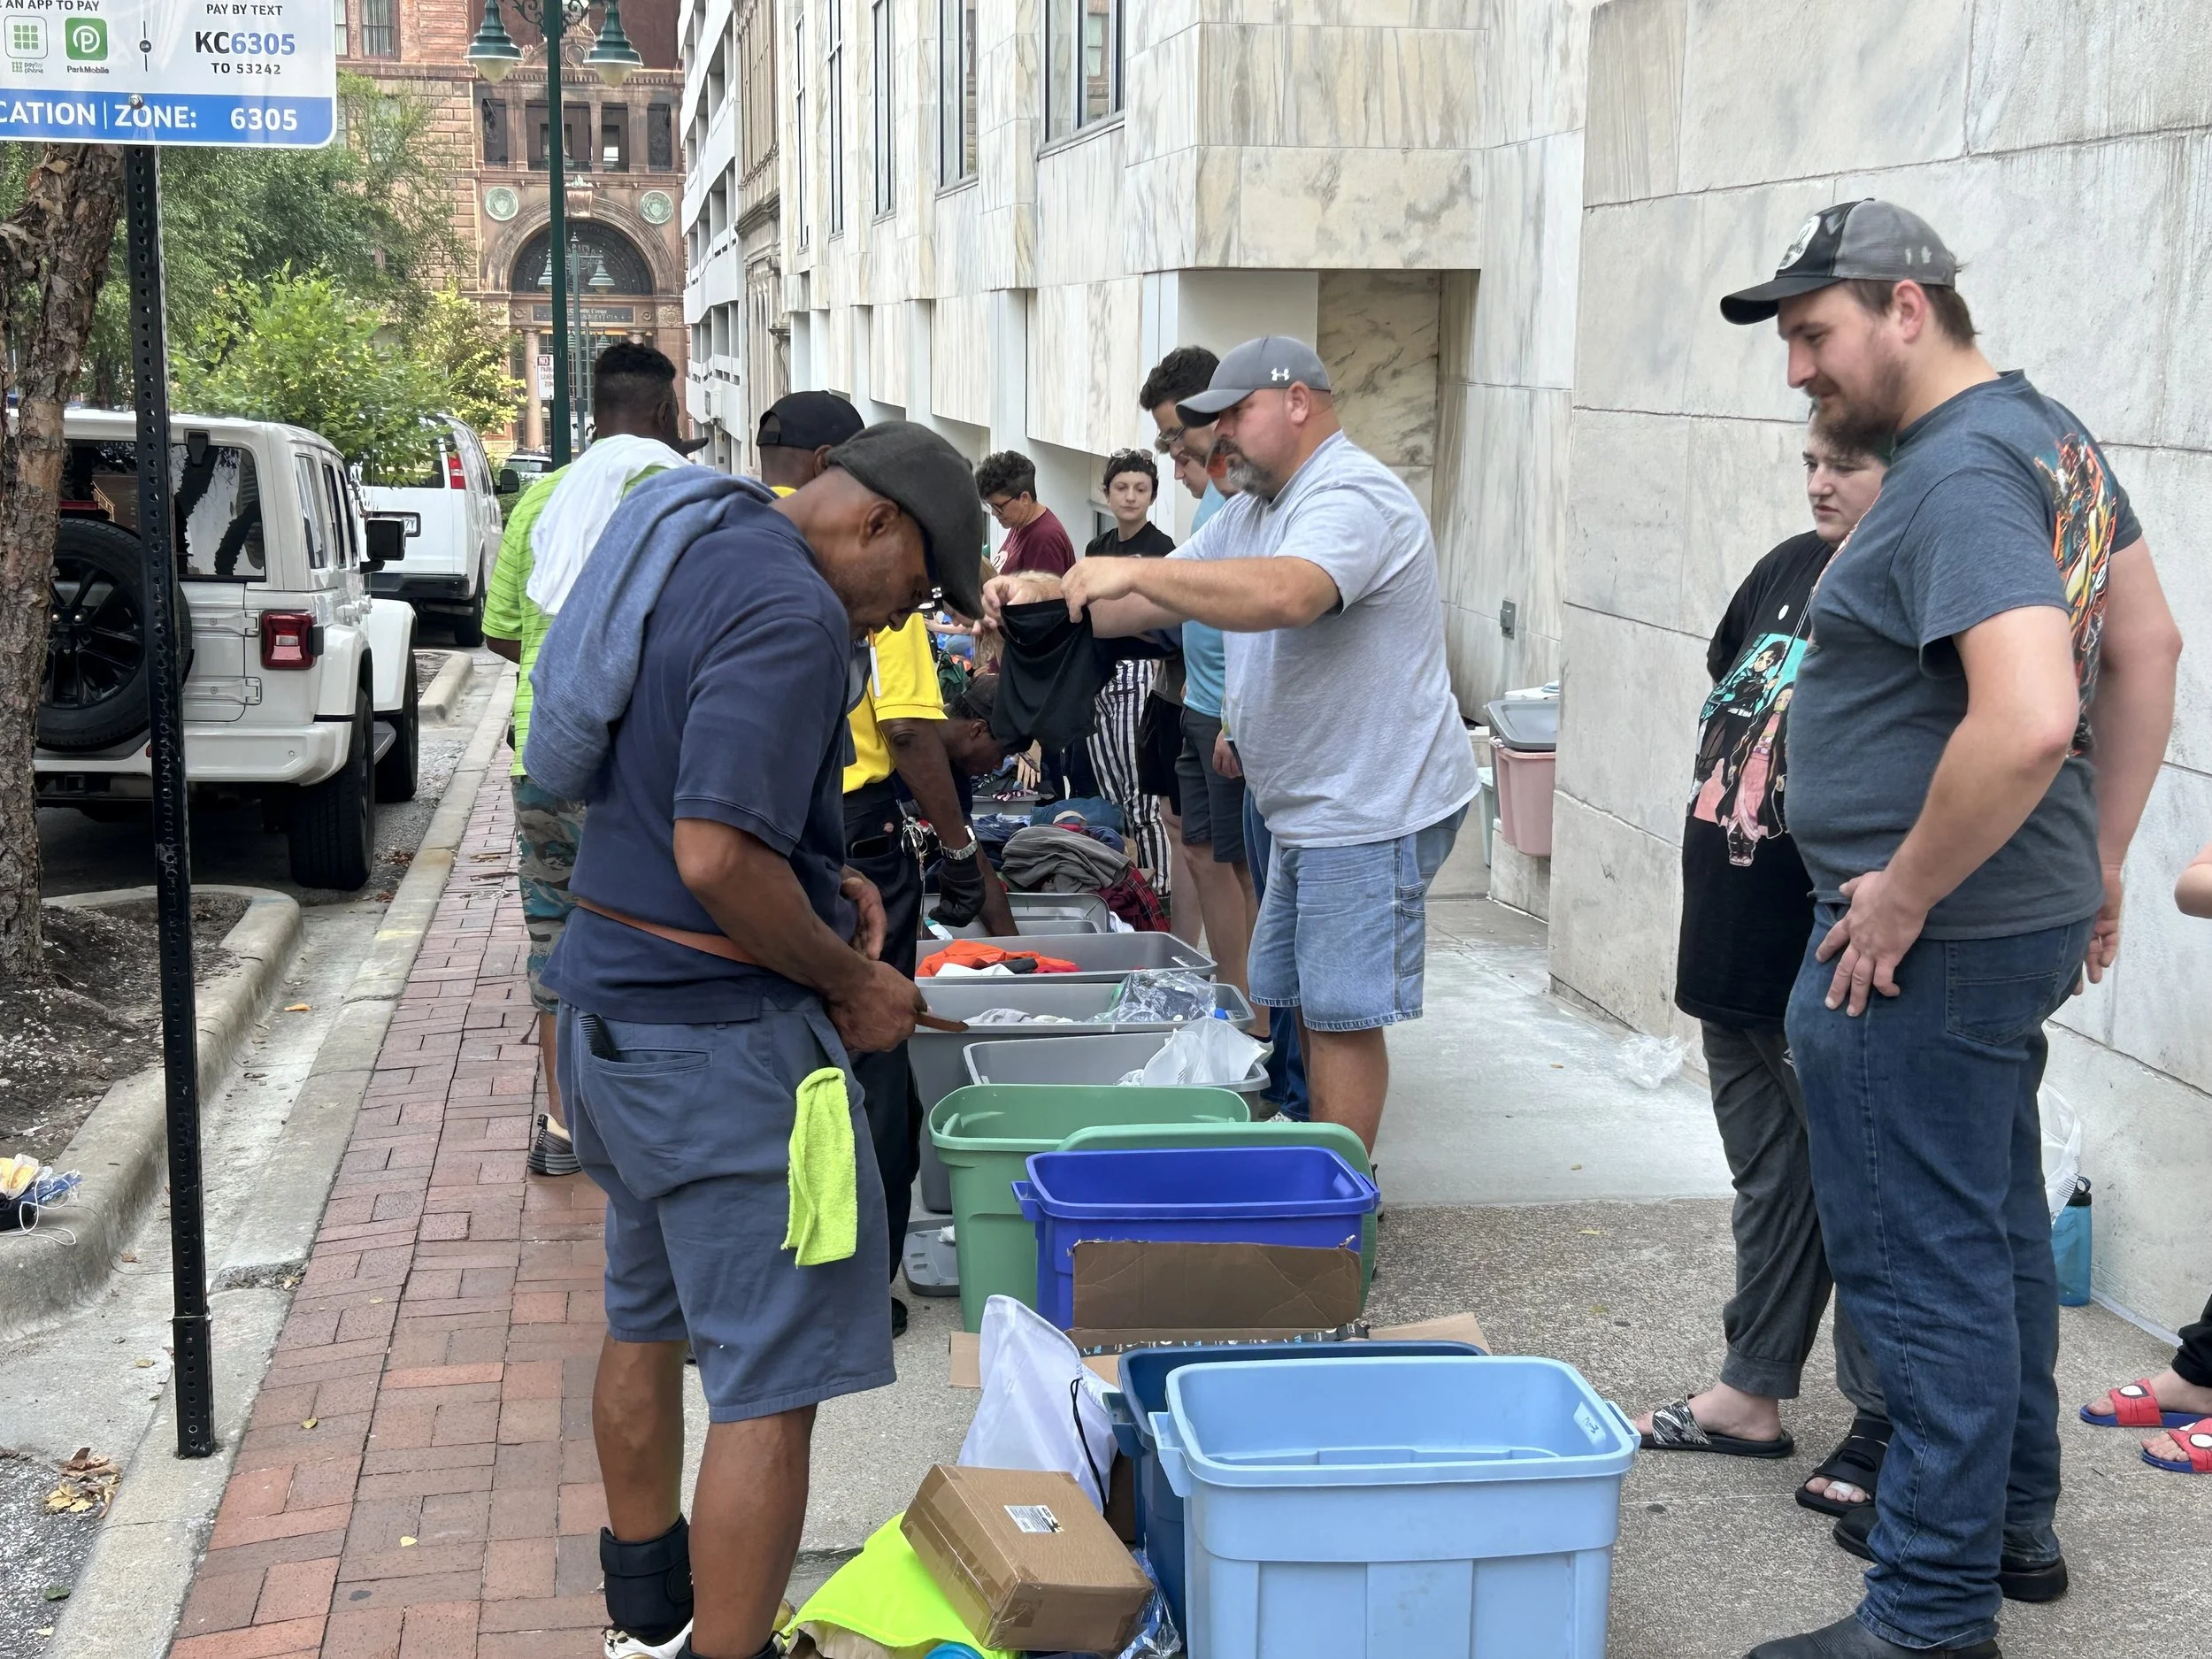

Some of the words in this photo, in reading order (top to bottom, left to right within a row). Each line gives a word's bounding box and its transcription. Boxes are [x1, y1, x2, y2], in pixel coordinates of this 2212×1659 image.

[5, 0, 23, 9] AN
[27, 0, 53, 10] APP
[56, 0, 73, 11] TO
[77, 0, 99, 12] PAY
[206, 4, 228, 15] PAY
[232, 4, 248, 15] BY
[250, 5, 283, 16] TEXT
[195, 31, 296, 55] KC6305
[211, 62, 231, 74] TO
[236, 63, 281, 75] 53242
[114, 104, 196, 128] ZONE:
[230, 107, 297, 130] 6305
